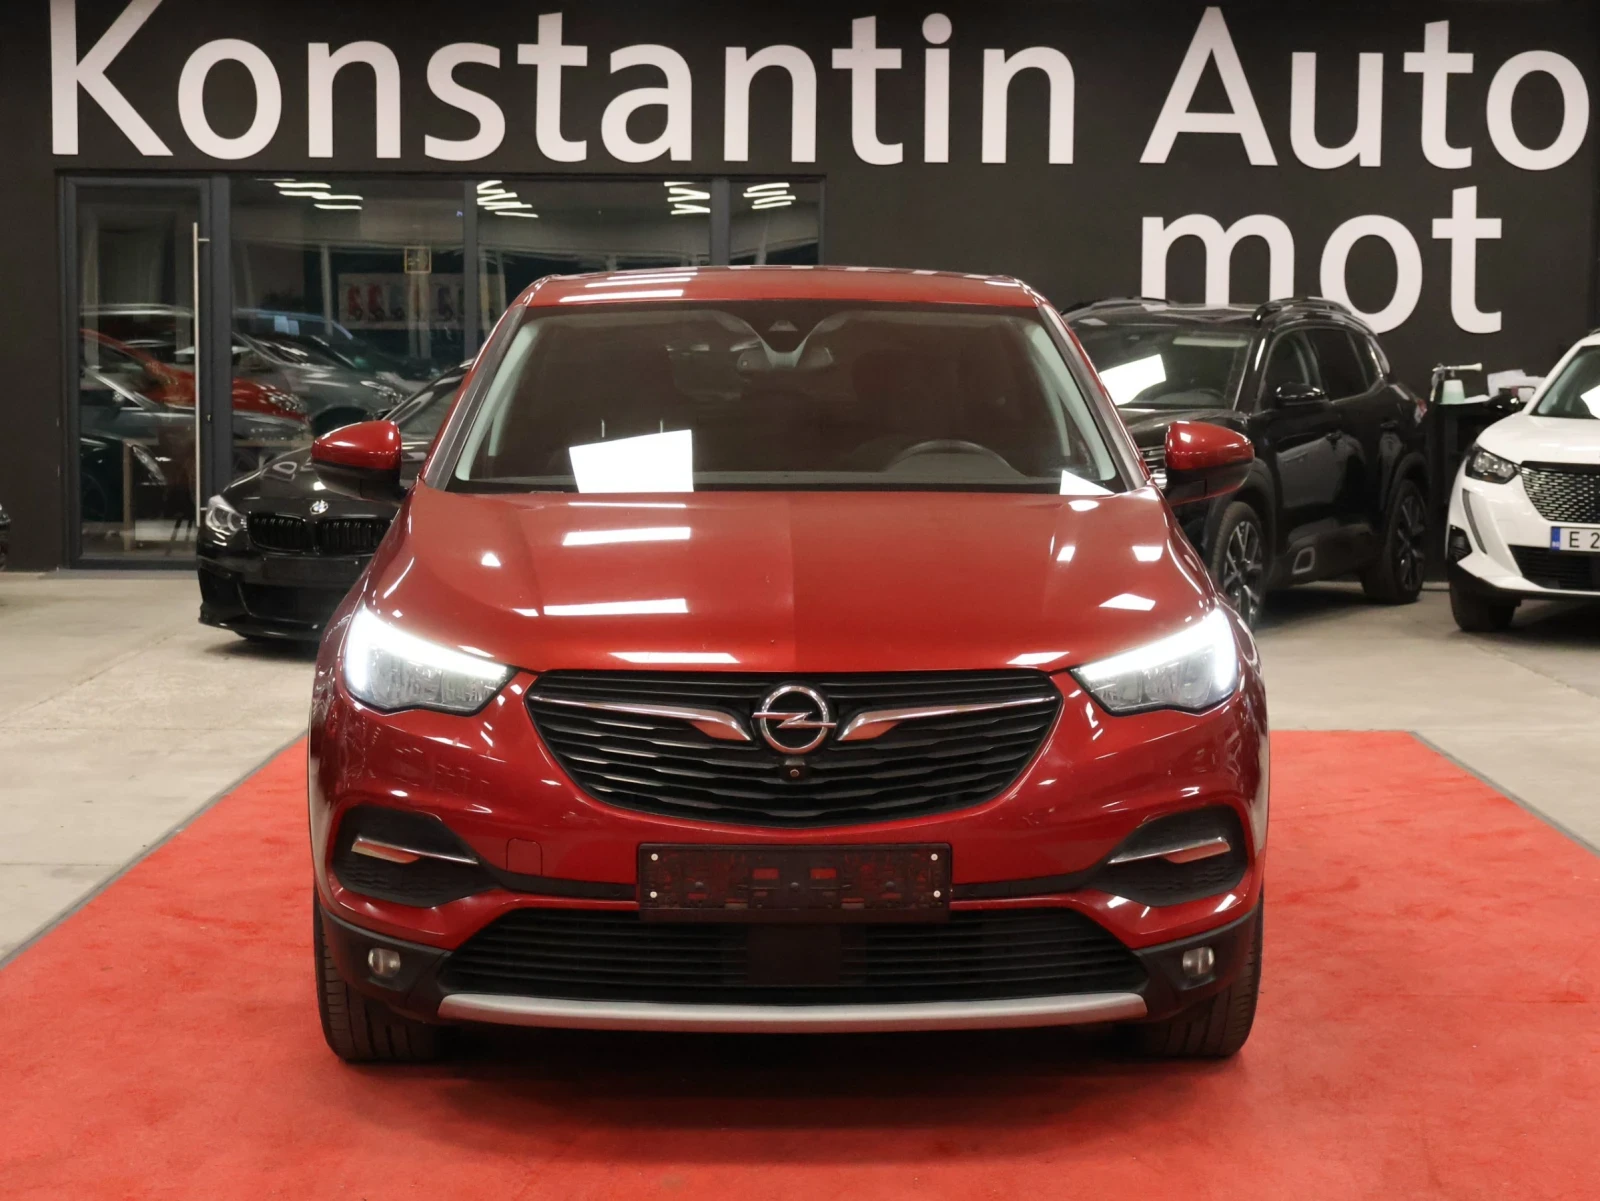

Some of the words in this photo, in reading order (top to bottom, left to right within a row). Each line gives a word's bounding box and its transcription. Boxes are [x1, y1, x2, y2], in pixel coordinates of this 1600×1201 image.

[50, 0, 1076, 165] Konstantin
[1139, 6, 1590, 171] Auto
[1141, 186, 1503, 335] mot
